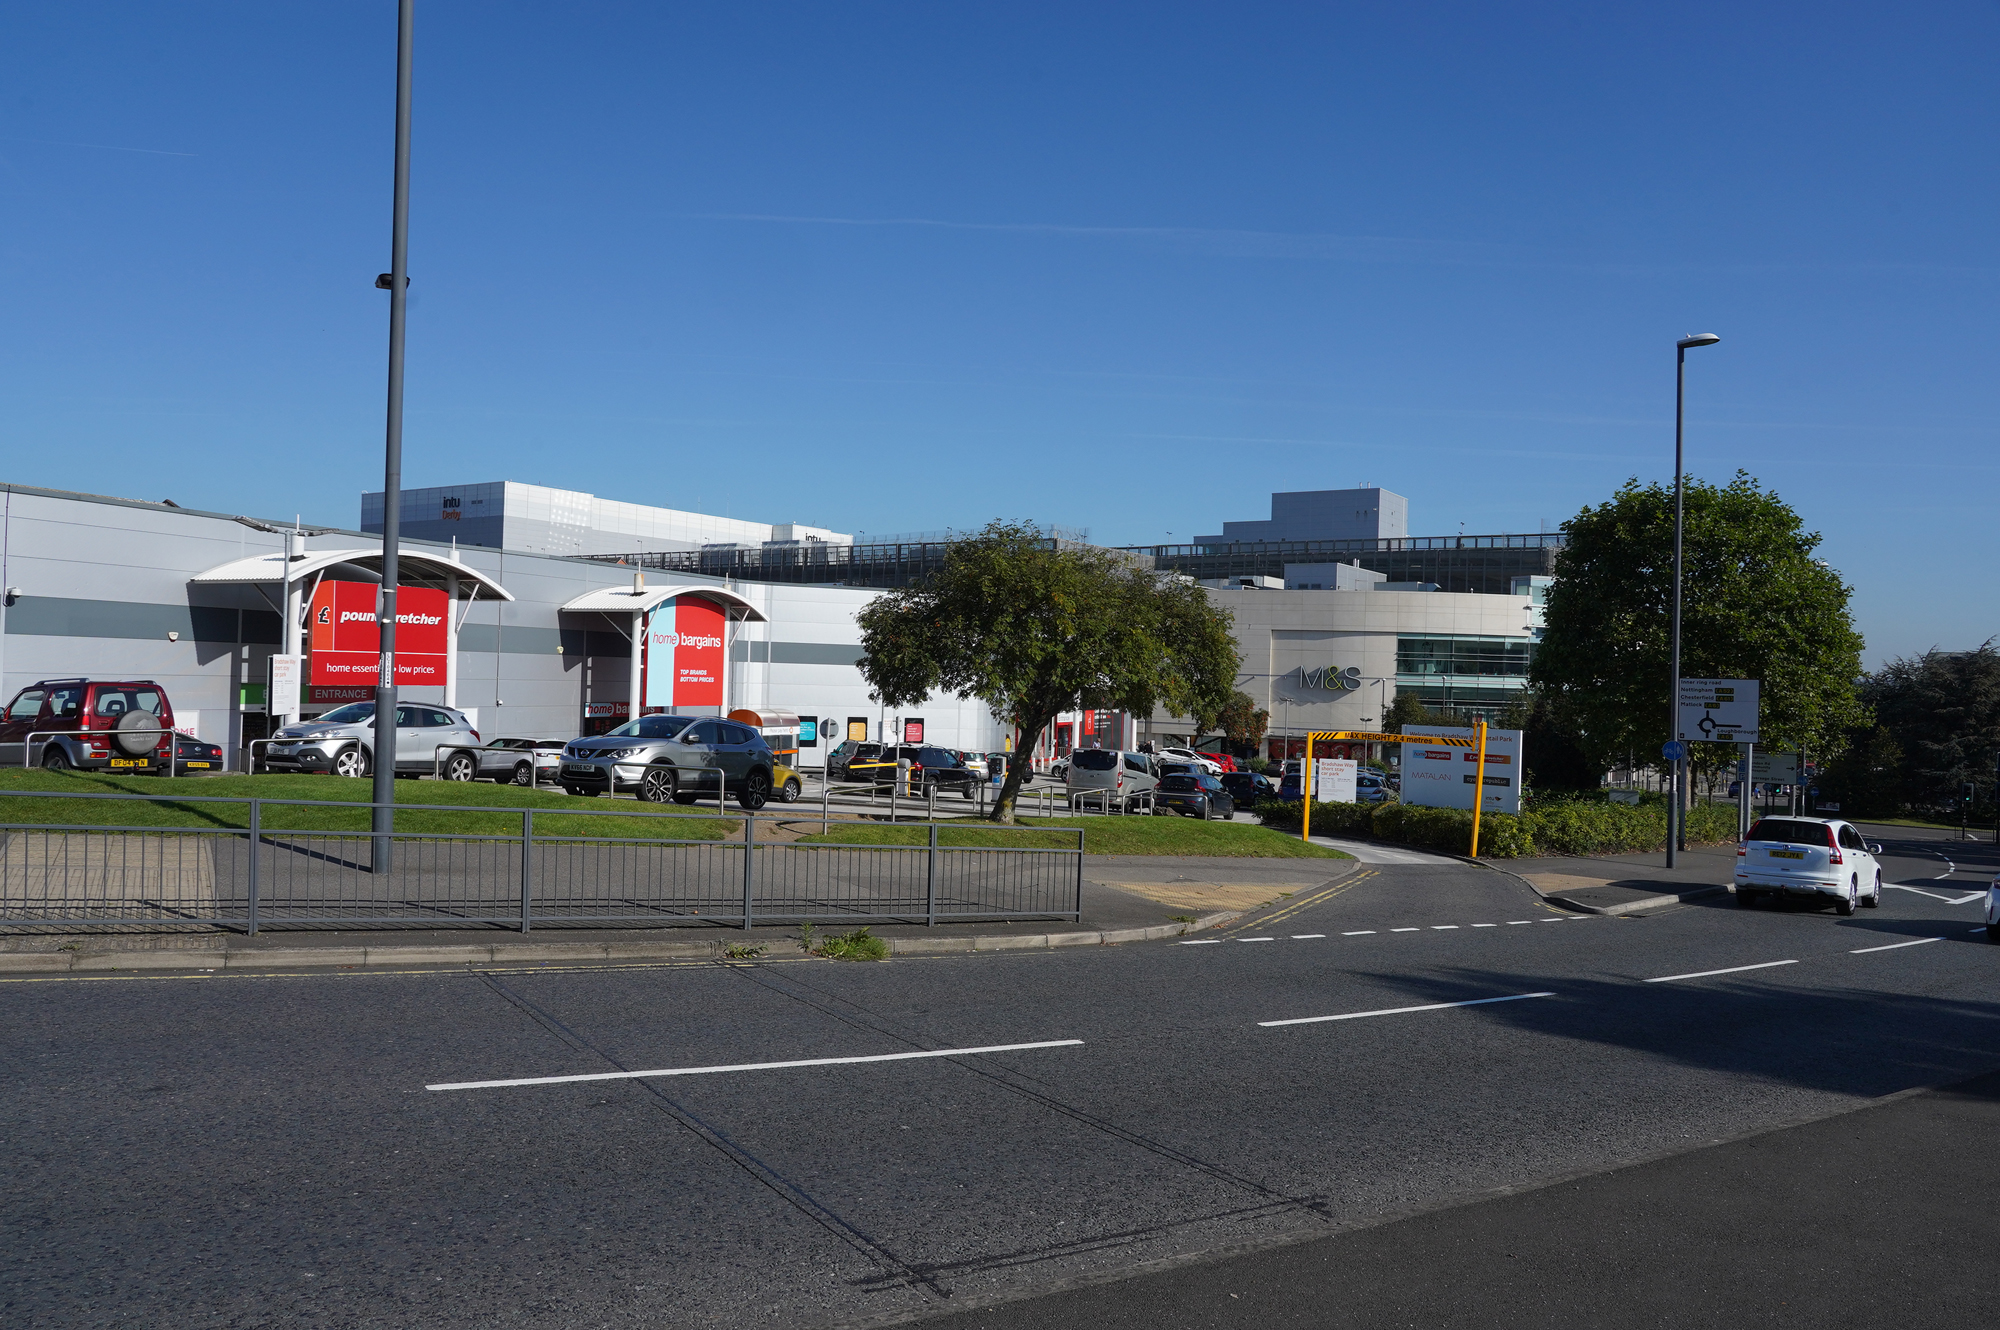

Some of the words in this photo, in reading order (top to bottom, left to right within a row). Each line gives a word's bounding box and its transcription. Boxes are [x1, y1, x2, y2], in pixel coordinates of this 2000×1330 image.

[443, 496, 460, 508] intu
[442, 509, 461, 521] Derby
[340, 611, 442, 625] pounretcher
[652, 632, 677, 645] home
[681, 633, 721, 649] bargains
[326, 663, 350, 673] home
[352, 665, 381, 673] essenti
[398, 664, 412, 673] low
[413, 665, 435, 675] prices
[1300, 665, 1362, 690] M&S
[315, 689, 367, 699] ENTRANCE
[588, 704, 613, 714] home
[1411, 772, 1452, 781] MATALAN
